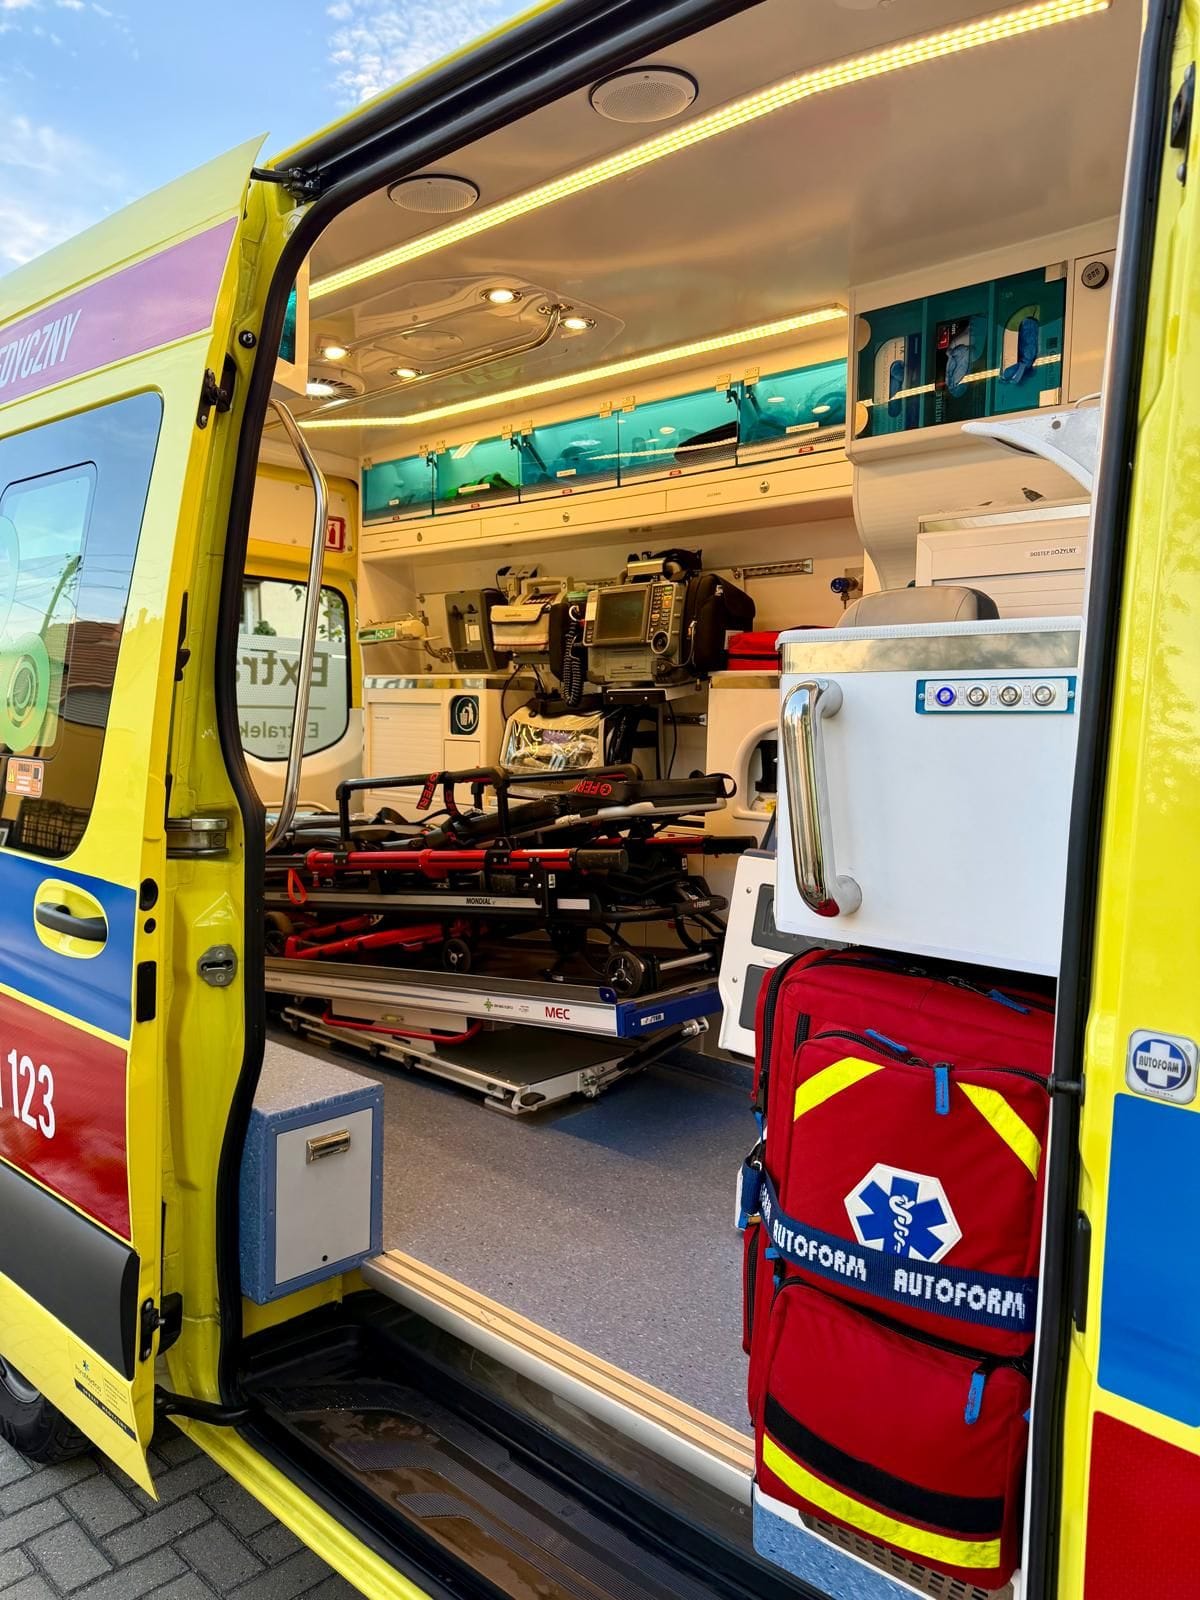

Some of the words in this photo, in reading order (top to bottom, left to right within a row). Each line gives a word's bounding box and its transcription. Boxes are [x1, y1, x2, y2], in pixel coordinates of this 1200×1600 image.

[465, 897, 491, 905] MONDIAL
[544, 1006, 571, 1020] MEC
[1139, 1055, 1179, 1073] AUTOFORM
[7, 1048, 56, 1139] 123
[773, 1219, 867, 1282] AUTOFORM
[893, 1269, 1026, 1320] AUTOFORM
